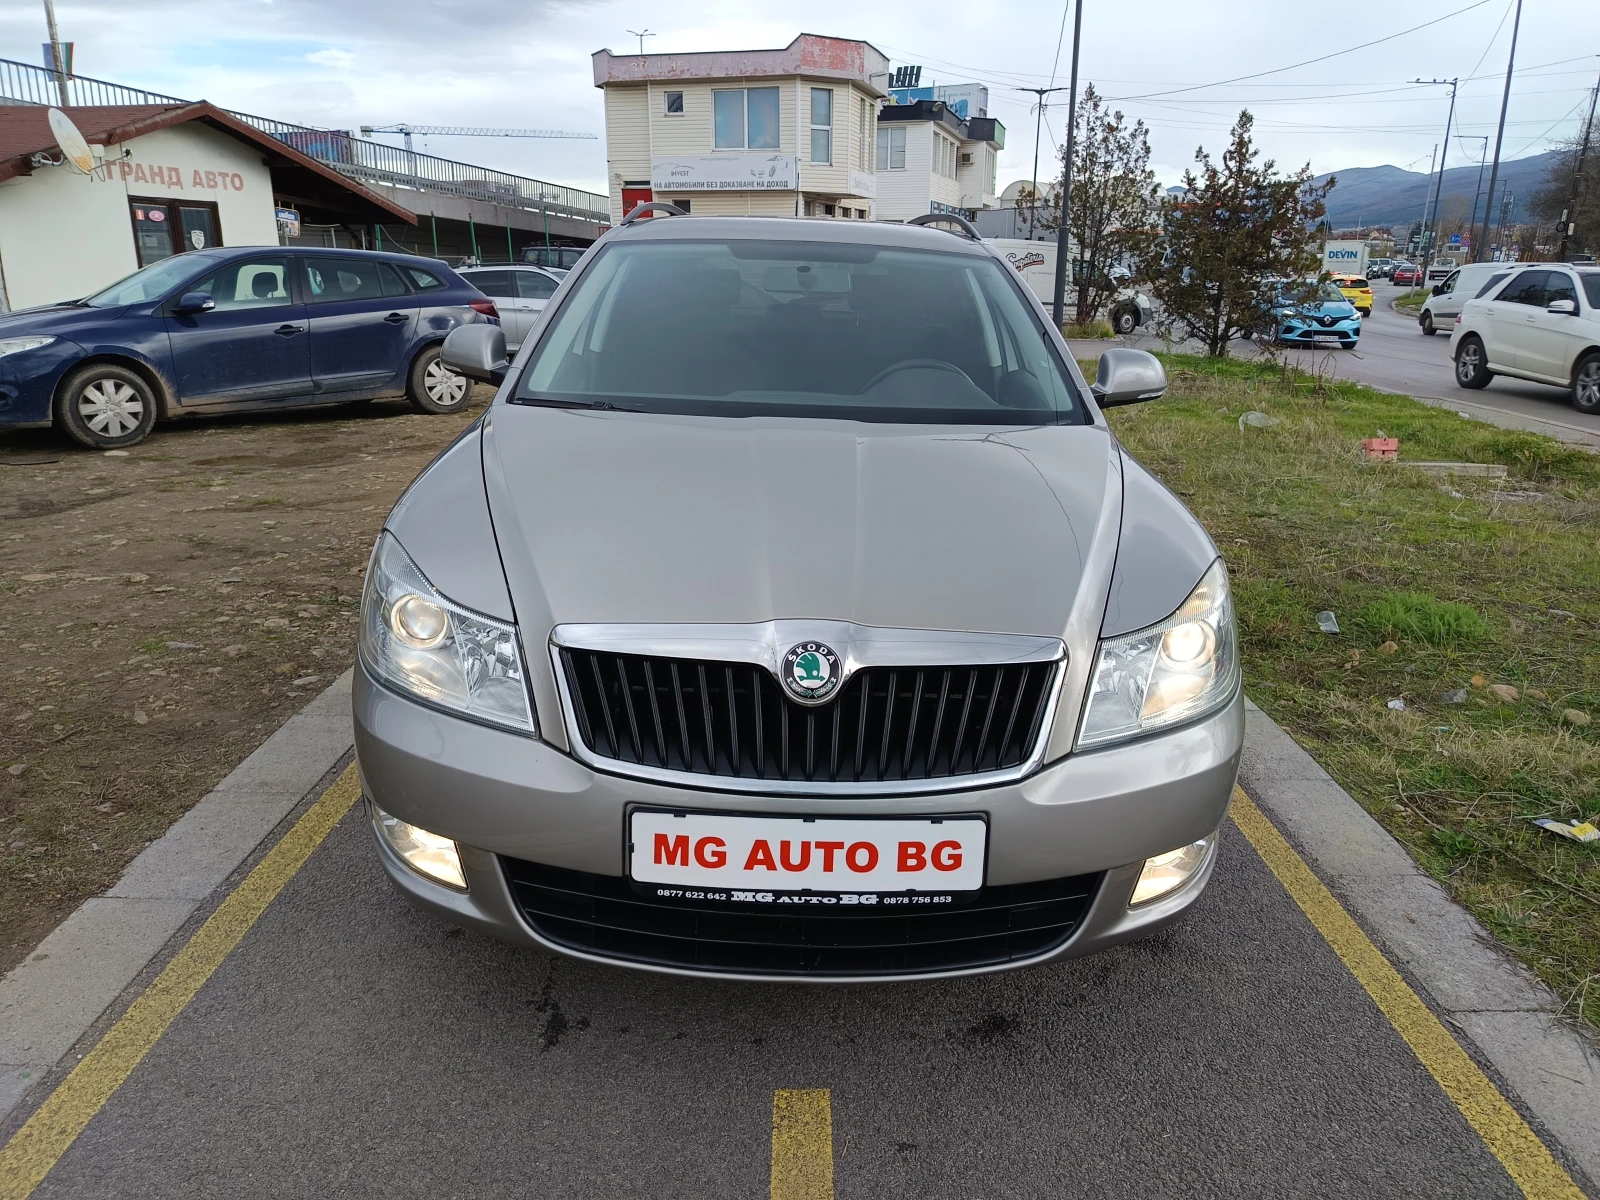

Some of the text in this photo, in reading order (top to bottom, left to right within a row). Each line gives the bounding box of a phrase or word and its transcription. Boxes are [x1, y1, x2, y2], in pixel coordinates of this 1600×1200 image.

[105, 160, 244, 192] ГРАНД АВТО
[664, 181, 705, 189] АВТОМОБИЛИ
[719, 181, 755, 189] ДОКАЗВАНЕ
[766, 181, 788, 189] ДОХОД
[1328, 249, 1358, 259] DEVIN
[653, 832, 963, 873] MG AUTO BG
[657, 889, 683, 898] 0877
[685, 891, 705, 899] 622
[731, 891, 775, 903] MG
[777, 896, 837, 904] AUTO
[840, 894, 879, 905] BG
[911, 896, 931, 904] 756
[933, 895, 952, 903] 853
